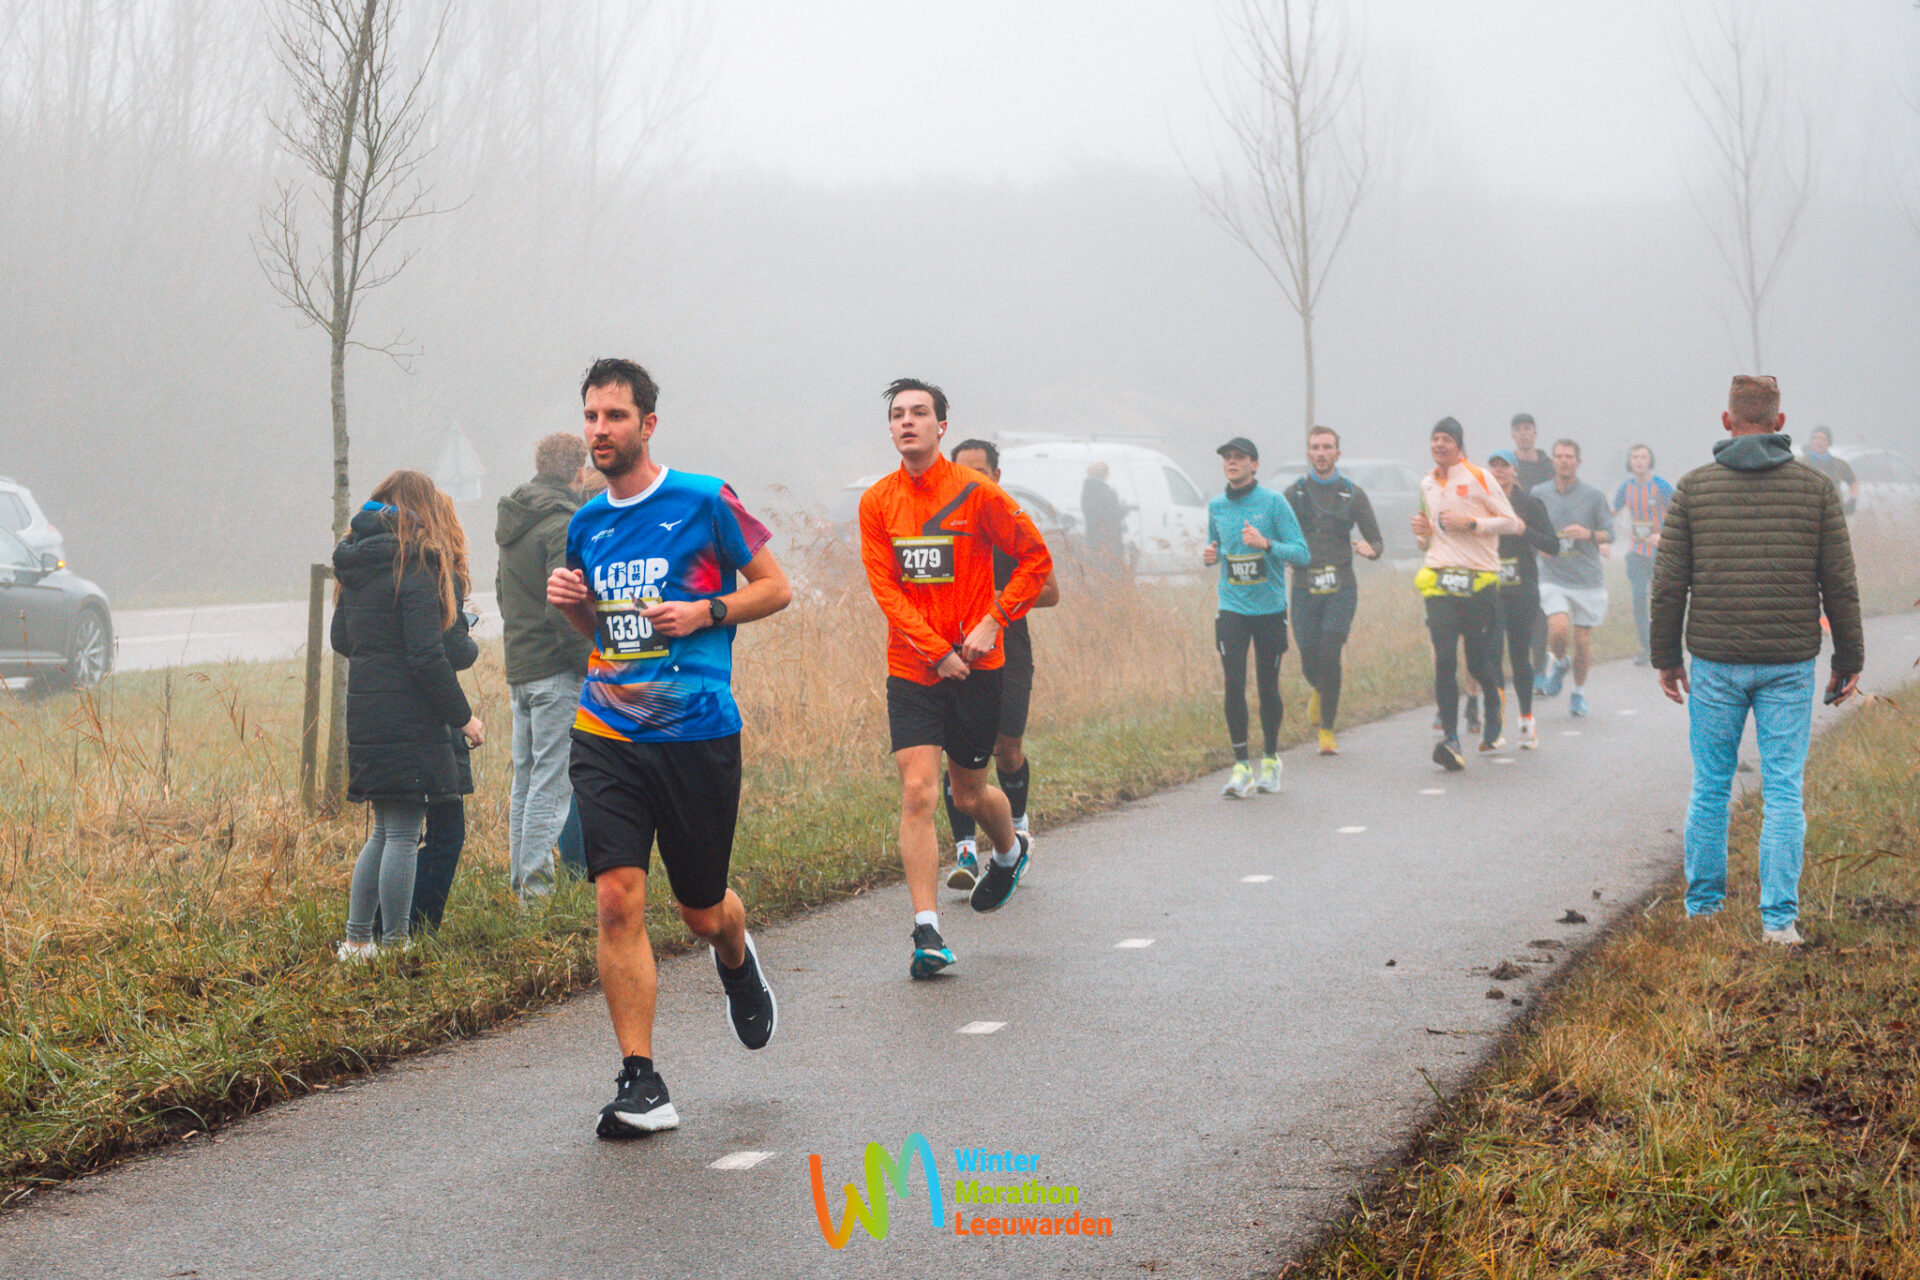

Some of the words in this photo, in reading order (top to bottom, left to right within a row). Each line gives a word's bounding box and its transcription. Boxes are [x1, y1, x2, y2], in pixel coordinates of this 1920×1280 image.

[902, 548, 942, 569] 2179
[594, 557, 669, 593] LOOP
[606, 614, 653, 641] 1330
